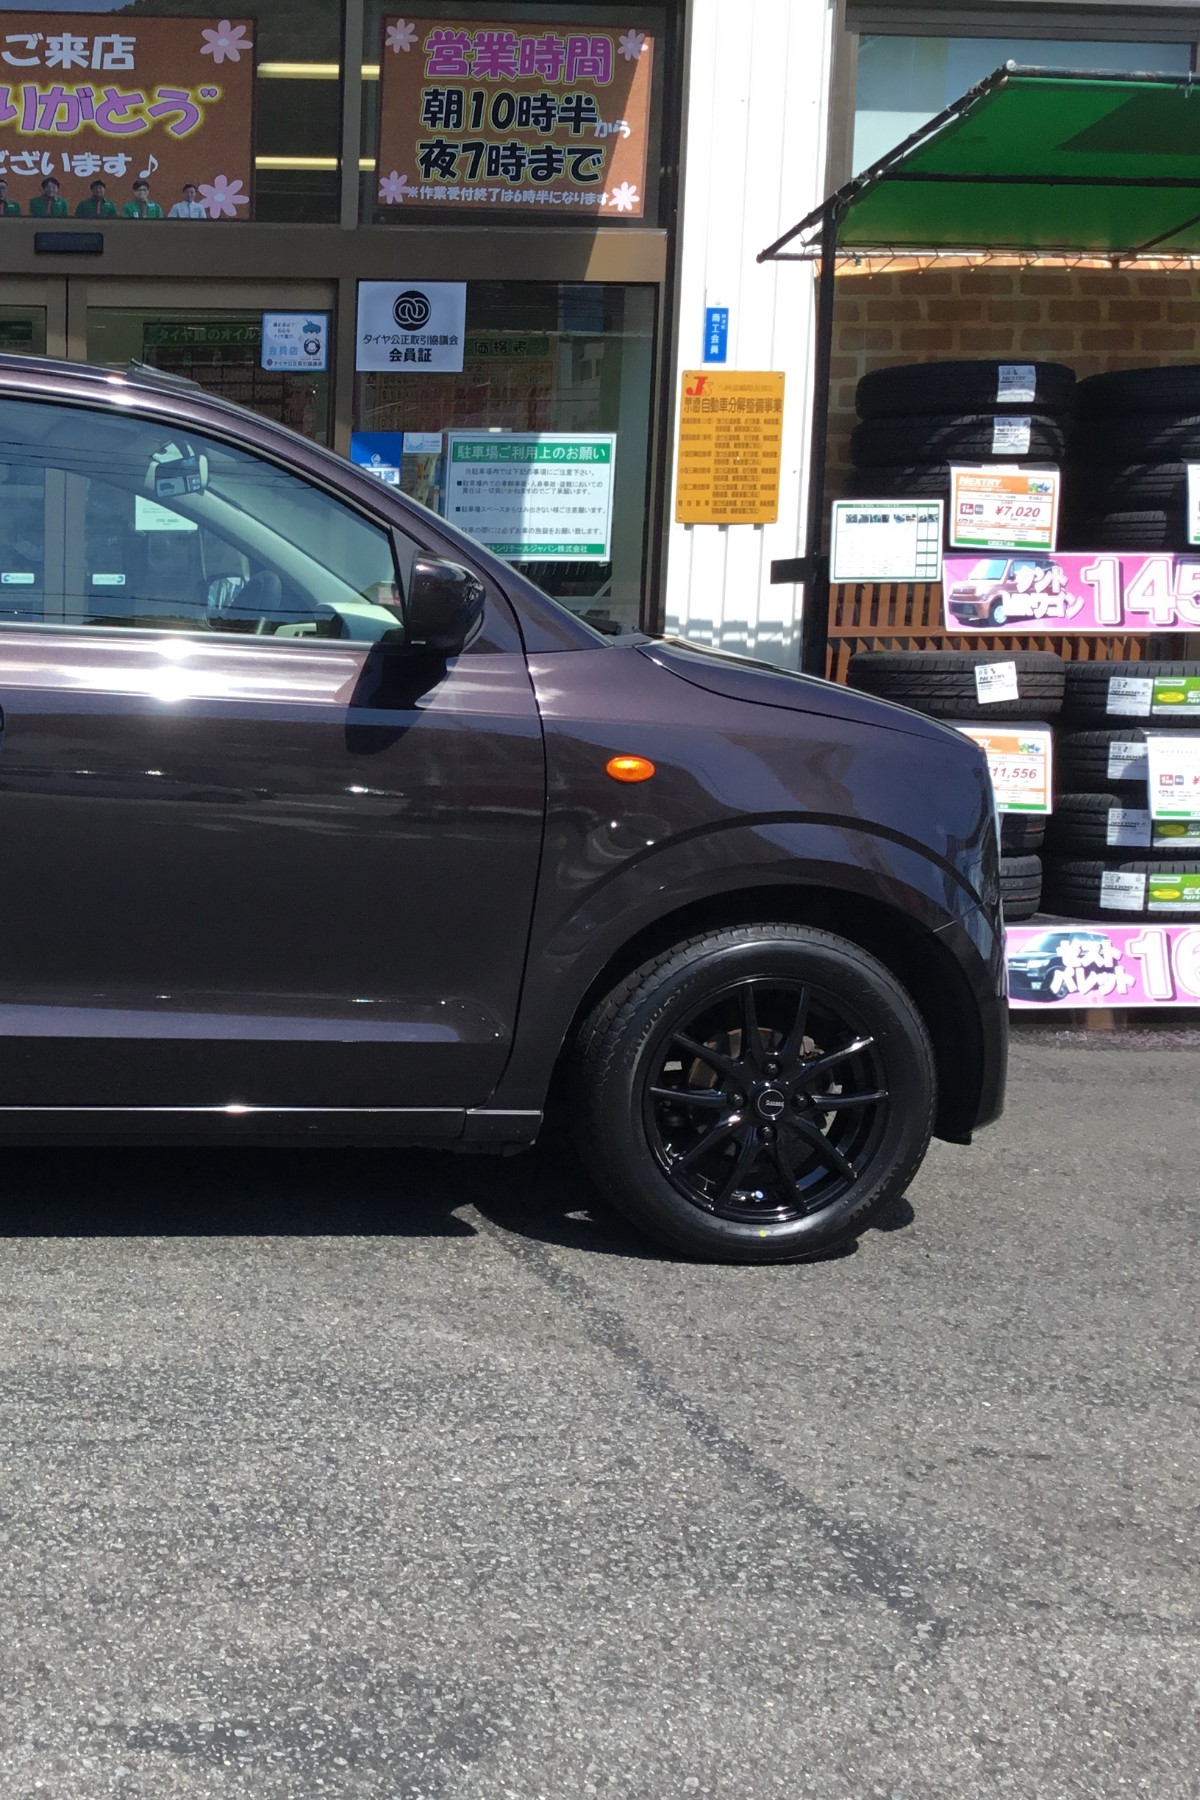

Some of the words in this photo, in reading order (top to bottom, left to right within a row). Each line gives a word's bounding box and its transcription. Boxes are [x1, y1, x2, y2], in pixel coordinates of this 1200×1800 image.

[0, 33, 137, 71] ご来店
[426, 29, 613, 84] 営業時間
[418, 139, 604, 184] 夜7時まで
[362, 334, 459, 346] タイヤ公正取引協議会
[389, 348, 432, 363] 会員証
[457, 445, 606, 461] 駐車場ご利用上のお願い
[958, 476, 1003, 488] NEXTRY
[995, 505, 1041, 518] ¥7,020
[989, 767, 1038, 779] 11,556
